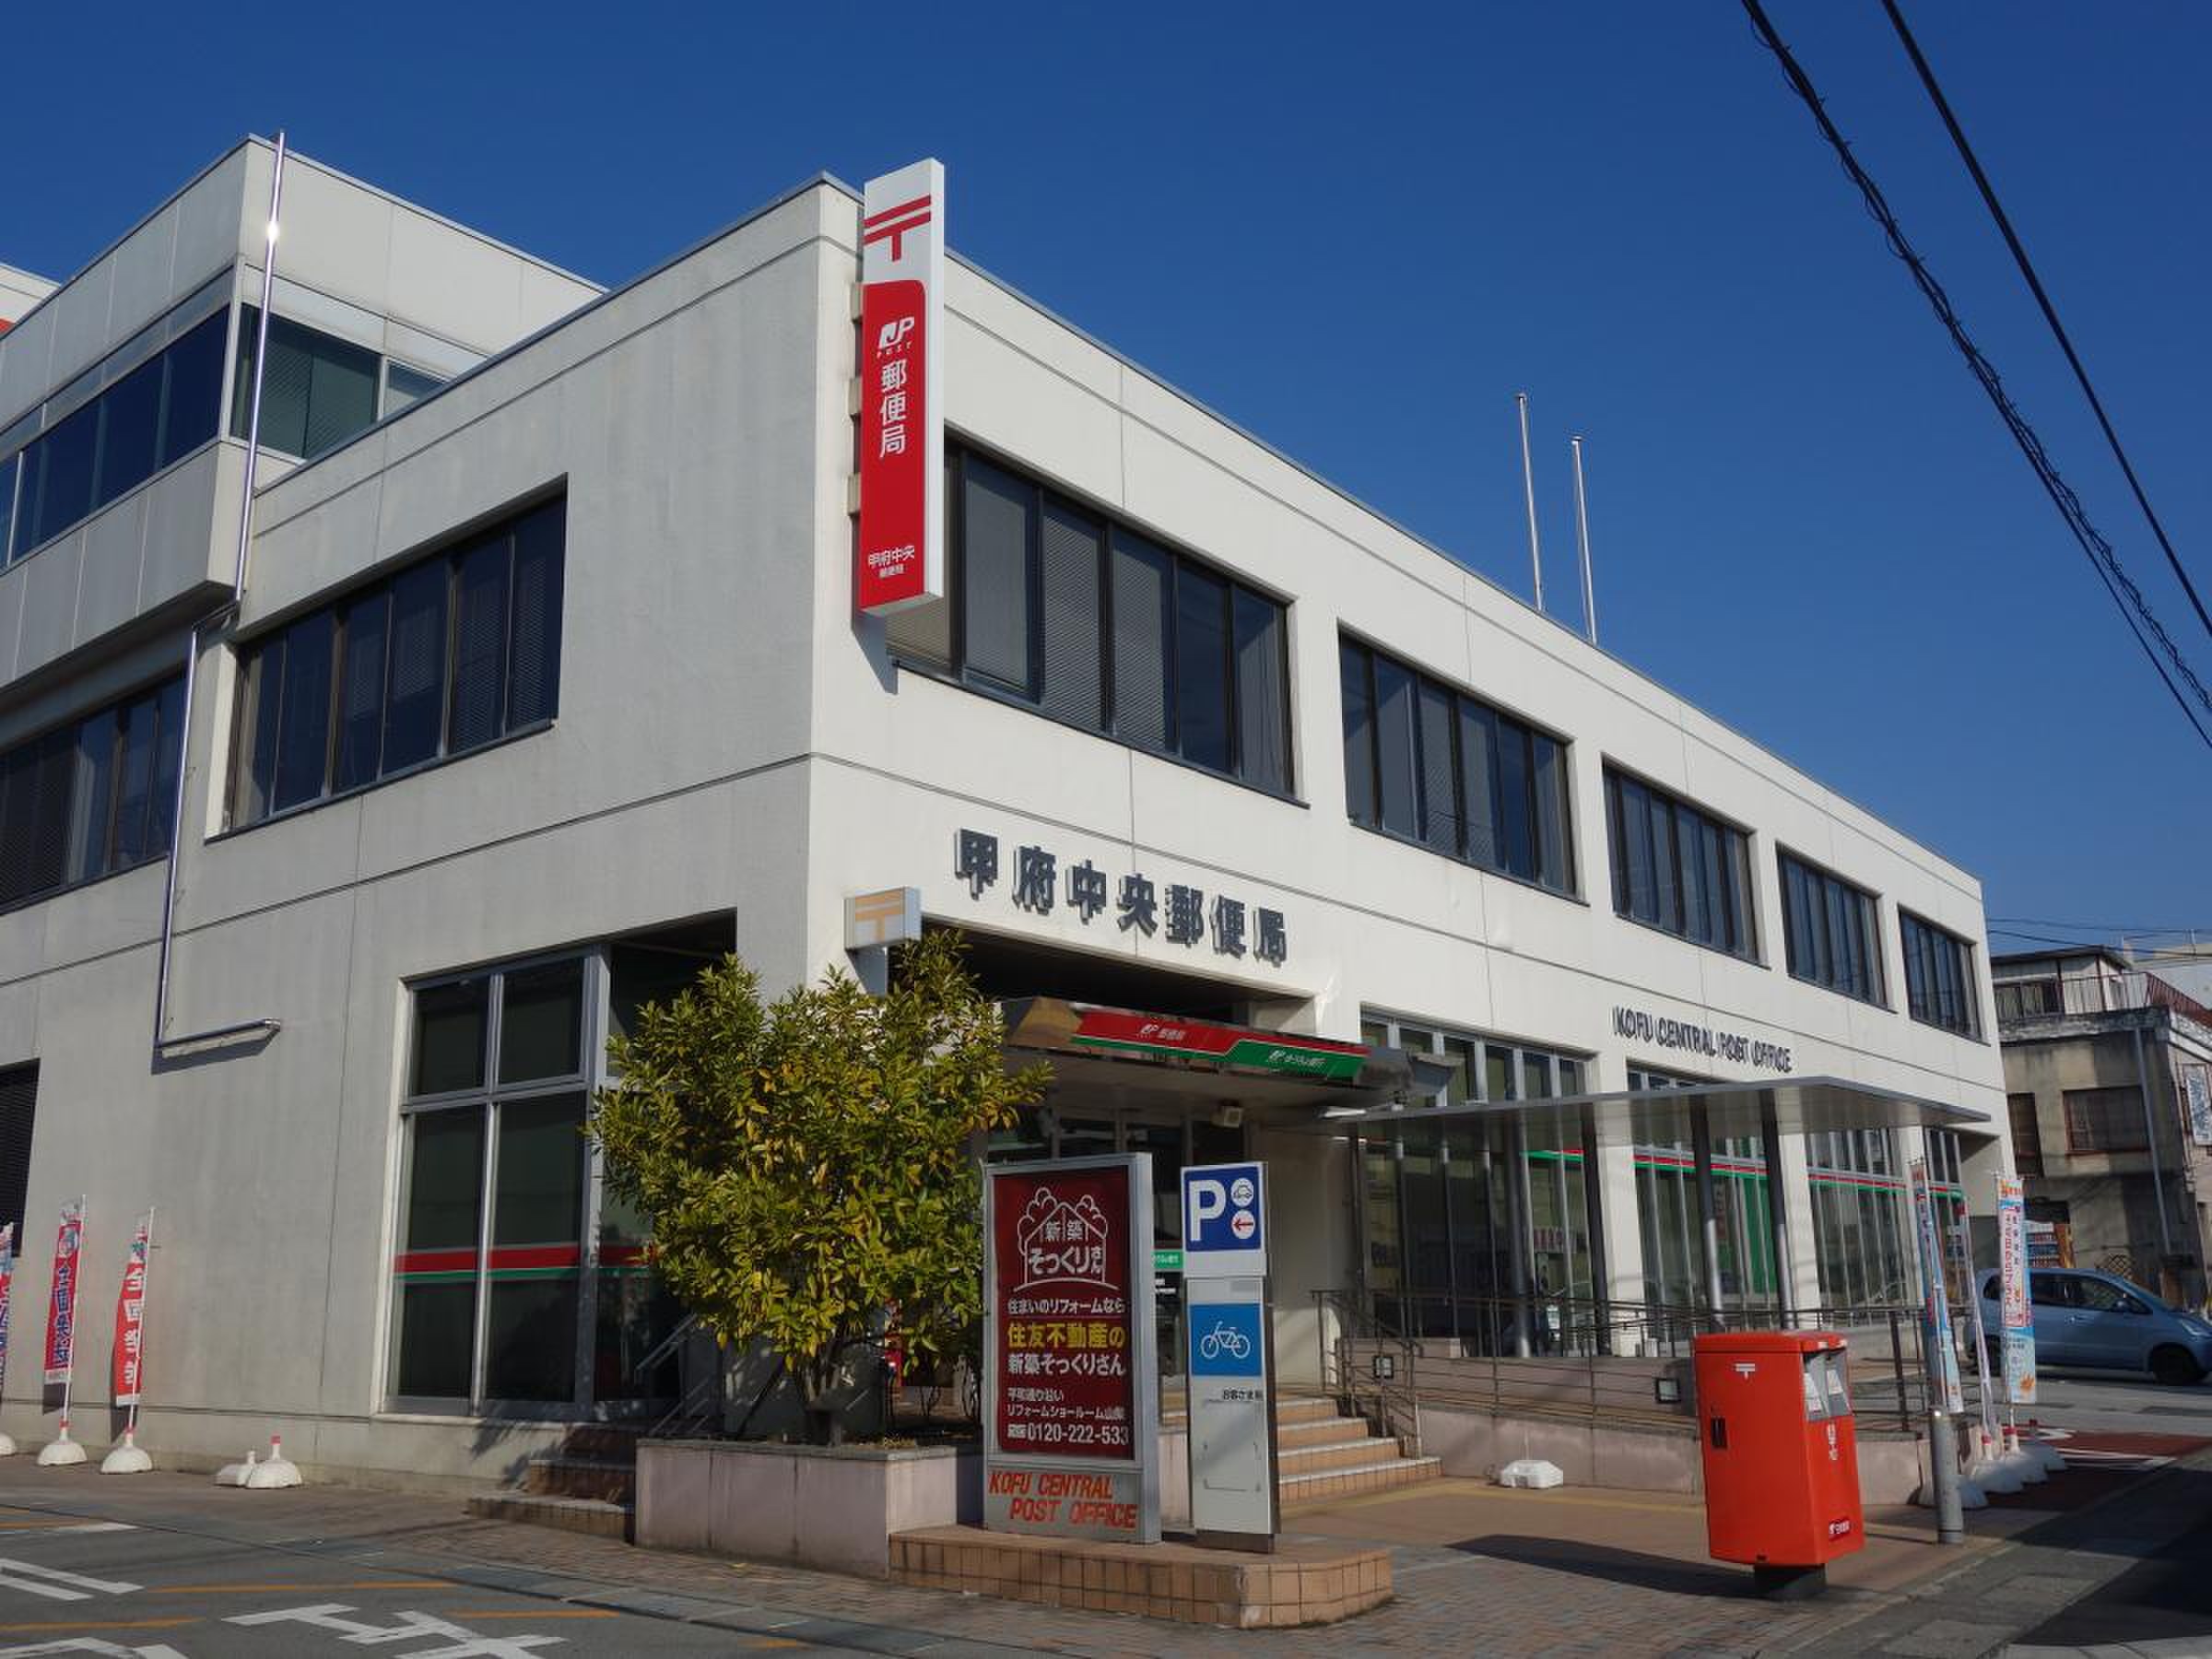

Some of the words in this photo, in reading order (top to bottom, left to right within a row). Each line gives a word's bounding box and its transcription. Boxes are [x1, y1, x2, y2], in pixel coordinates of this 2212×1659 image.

[879, 359, 907, 458] 郵便局
[868, 545, 914, 569] 甲府中央
[955, 828, 1287, 968] 甲府中央郵便局
[1609, 1006, 1653, 1043] KOFU
[1655, 1018, 1716, 1056] CENTRAL
[1717, 1031, 1749, 1065] POST
[1752, 1040, 1793, 1074] OFFICE
[1189, 1180, 1226, 1241] P
[1045, 1219, 1083, 1241] 新築
[1007, 1298, 1124, 1314] 住まいのリフォームなら
[1007, 1323, 1124, 1348] 住友不動産の
[1007, 1353, 1125, 1376] 新築そっくりさん
[1028, 1422, 1129, 1445] 0120-222-533
[988, 1469, 1033, 1495] KOFU
[1037, 1473, 1114, 1500] CENTRAL
[1009, 1497, 1063, 1523] POST
[1068, 1502, 1138, 1529] OFFICE
